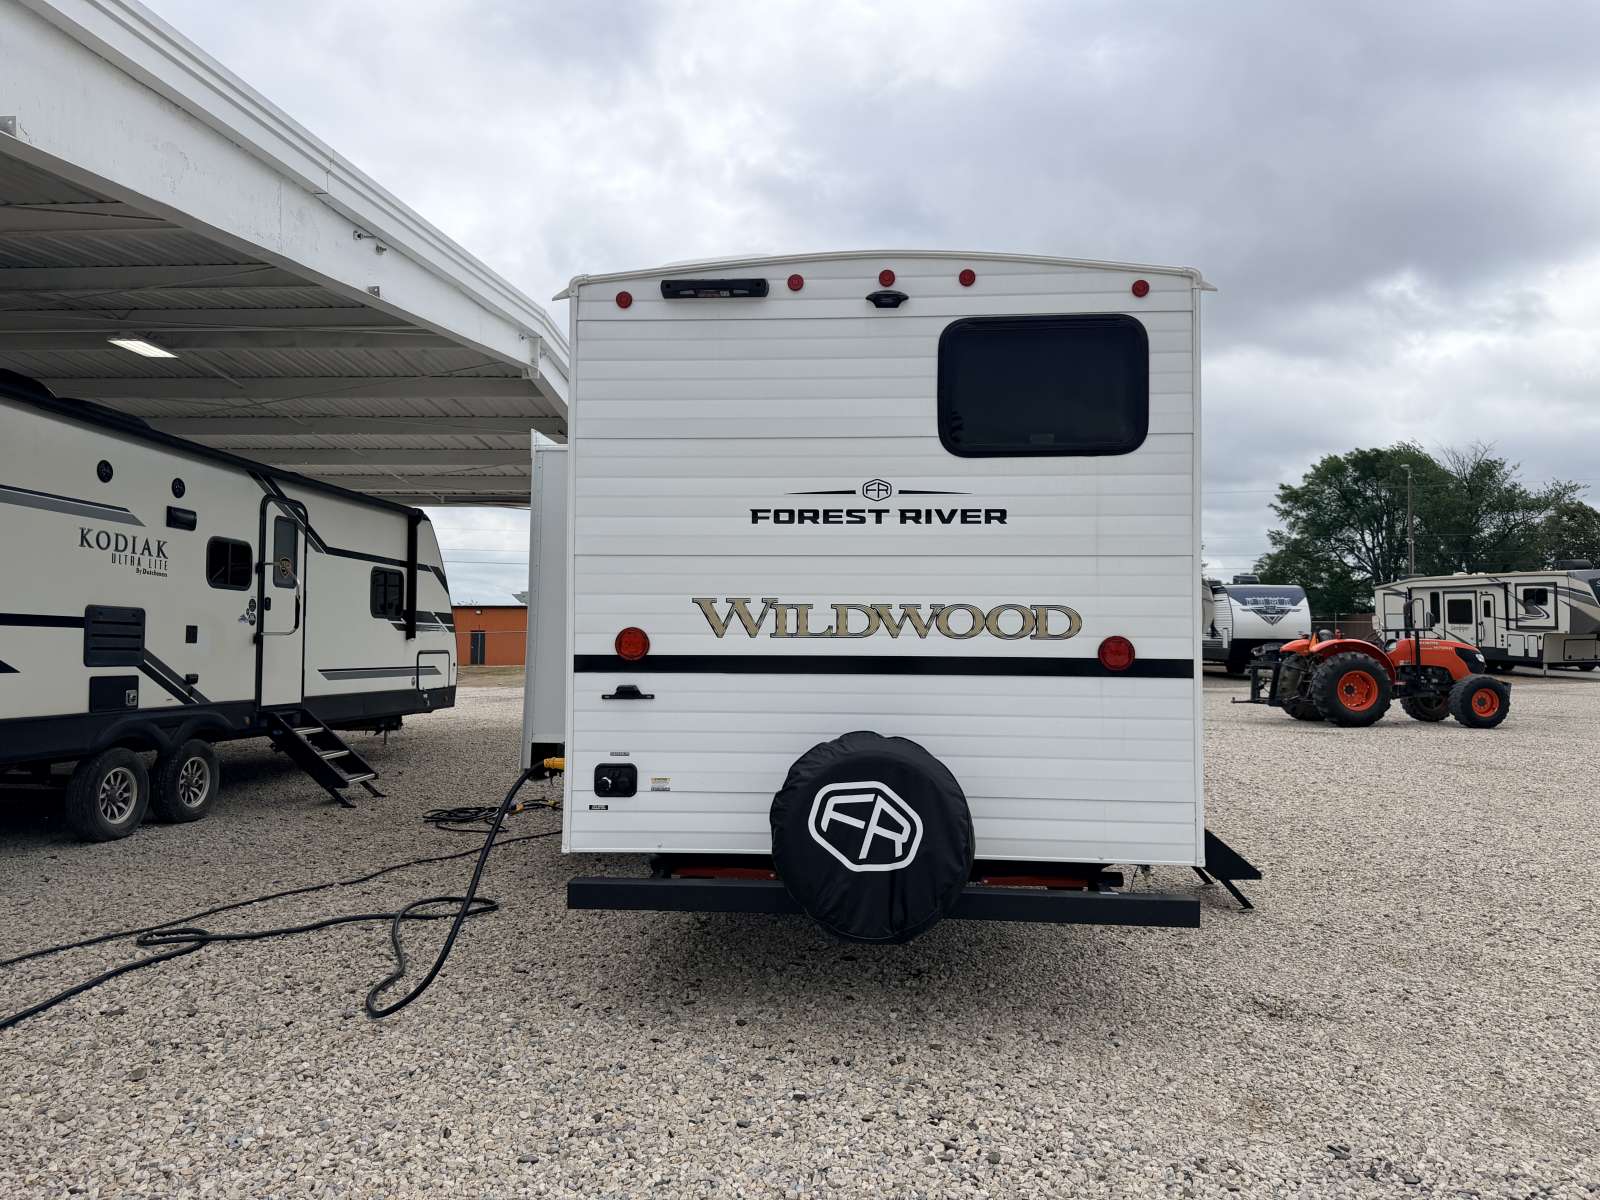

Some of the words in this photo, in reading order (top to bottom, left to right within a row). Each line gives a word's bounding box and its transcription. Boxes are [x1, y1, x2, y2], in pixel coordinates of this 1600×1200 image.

[750, 509, 890, 525] FOREST
[898, 509, 1008, 525] RIVER
[78, 527, 168, 559] KODIAK
[111, 552, 141, 567] ULTRA
[148, 559, 168, 570] LITE
[692, 597, 1082, 640] WILDWOOD
[820, 793, 911, 860] FR
